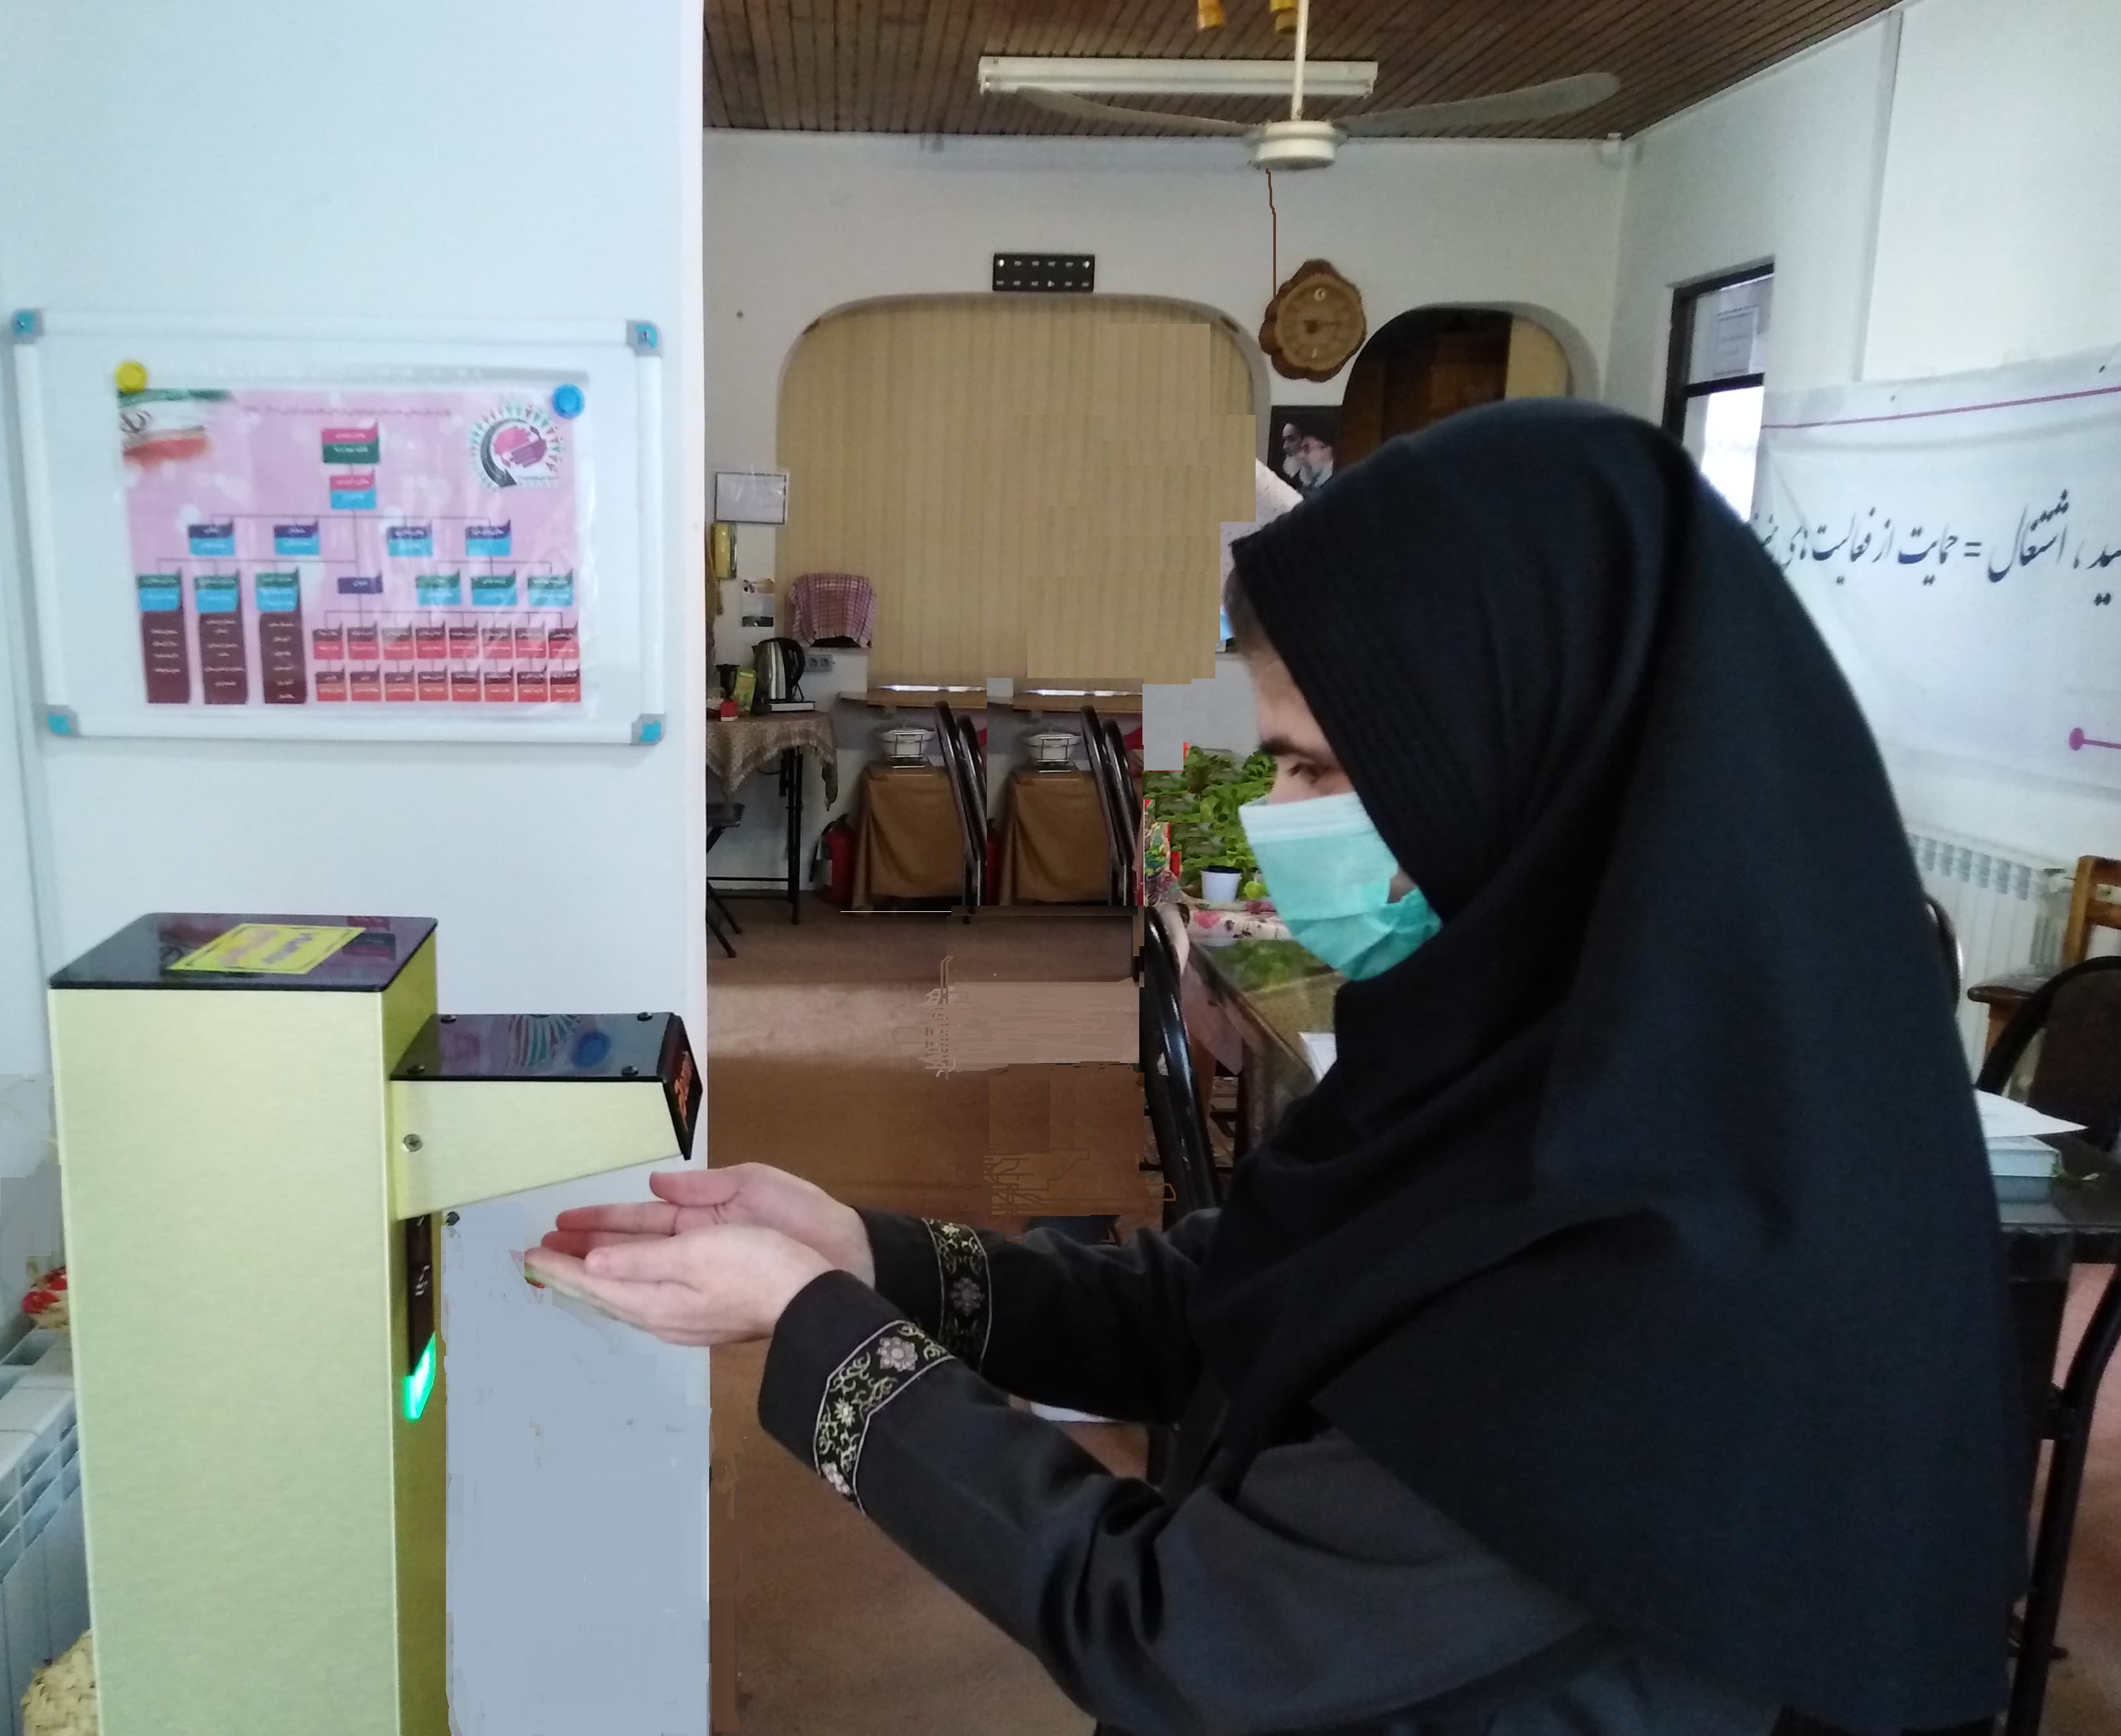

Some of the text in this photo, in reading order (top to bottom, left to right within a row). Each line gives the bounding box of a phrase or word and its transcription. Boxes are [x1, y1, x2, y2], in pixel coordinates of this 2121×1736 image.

[1872, 517, 1896, 563] از
[1898, 522, 1959, 585] حمایت
[1987, 488, 2070, 583] اشتغال
